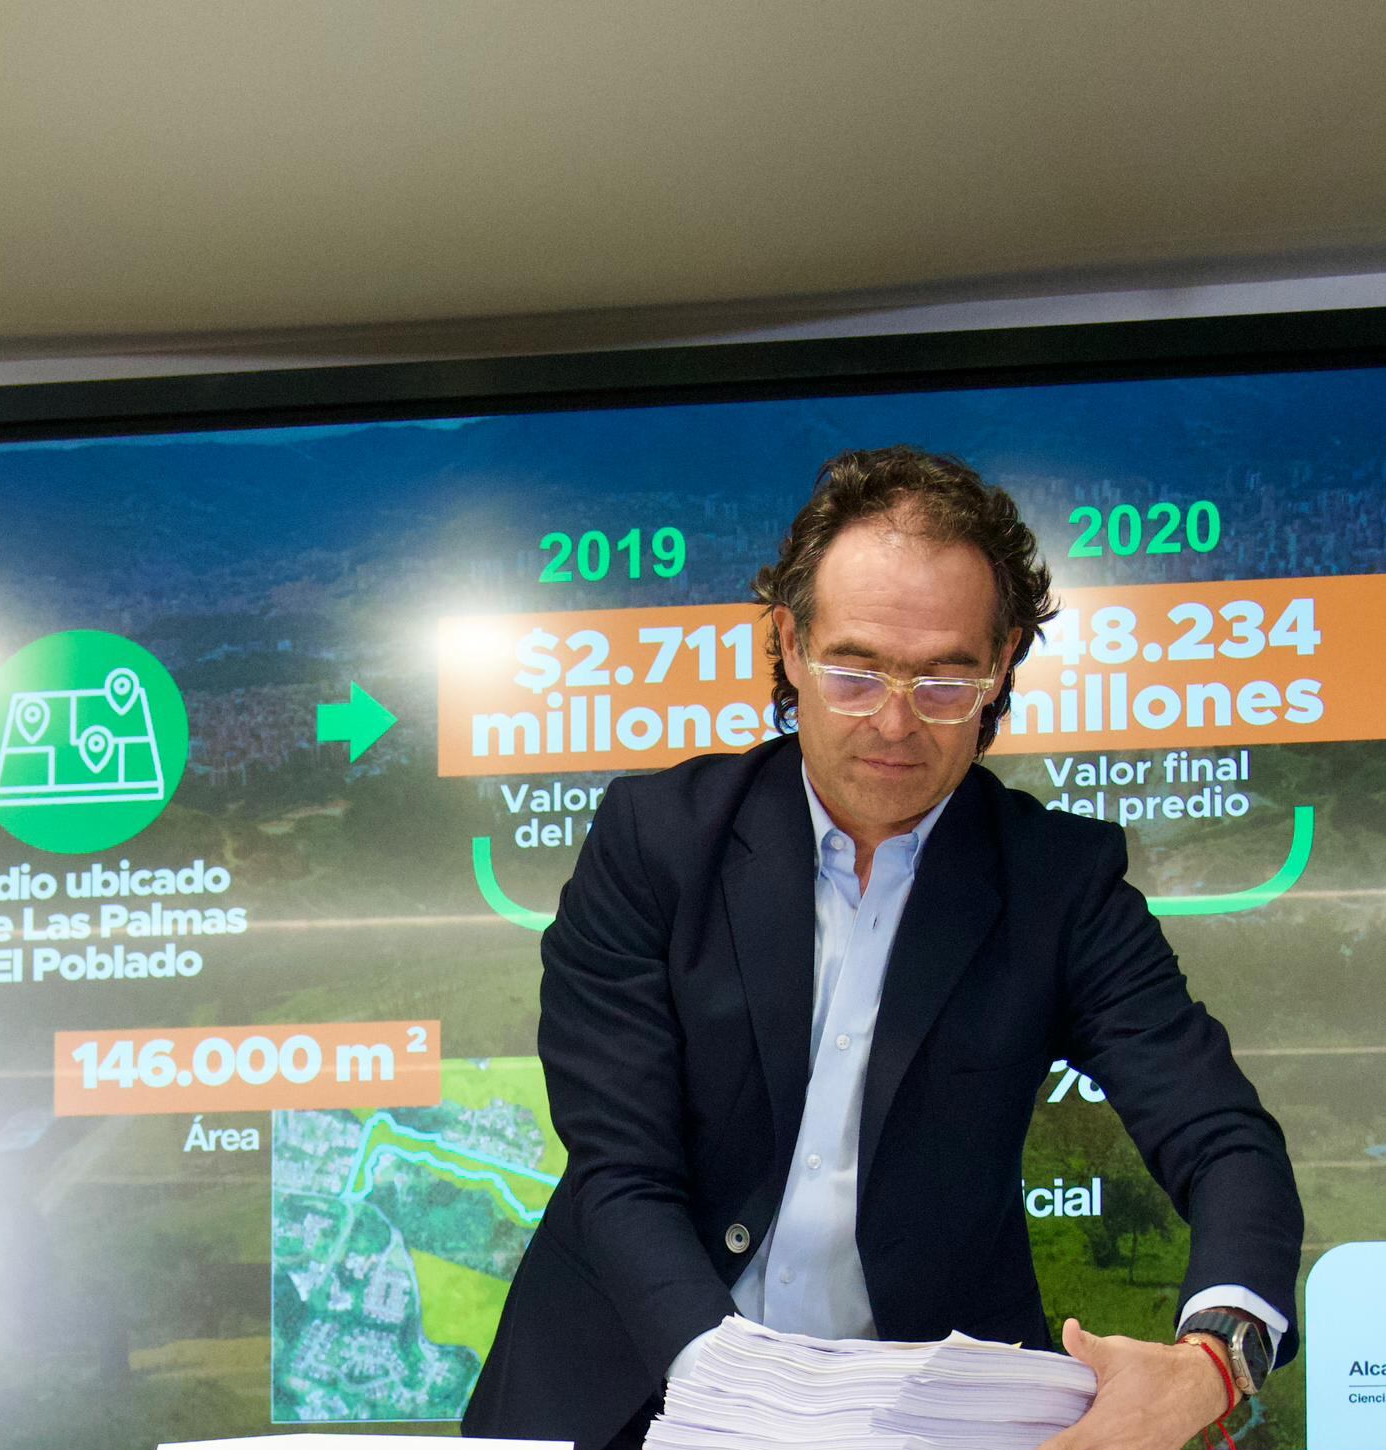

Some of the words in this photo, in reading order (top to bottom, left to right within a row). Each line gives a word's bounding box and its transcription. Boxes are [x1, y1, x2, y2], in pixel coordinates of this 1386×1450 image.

[1068, 501, 1221, 558] 2020
[539, 526, 686, 583] 2019
[1016, 598, 1321, 666] 48.234
[514, 628, 752, 694] $2.711
[1044, 756, 1151, 787] Valor
[1163, 750, 1249, 783] final
[501, 782, 604, 813] Valor
[1119, 785, 1250, 827] predio
[515, 817, 572, 848] del
[66, 858, 231, 900] ubicado
[22, 906, 91, 943] Las
[100, 900, 247, 938] Palmas
[33, 943, 203, 981] Poblado
[72, 1035, 322, 1089] 146.000
[184, 1116, 259, 1153] Área
[1022, 1178, 1101, 1217] cial
